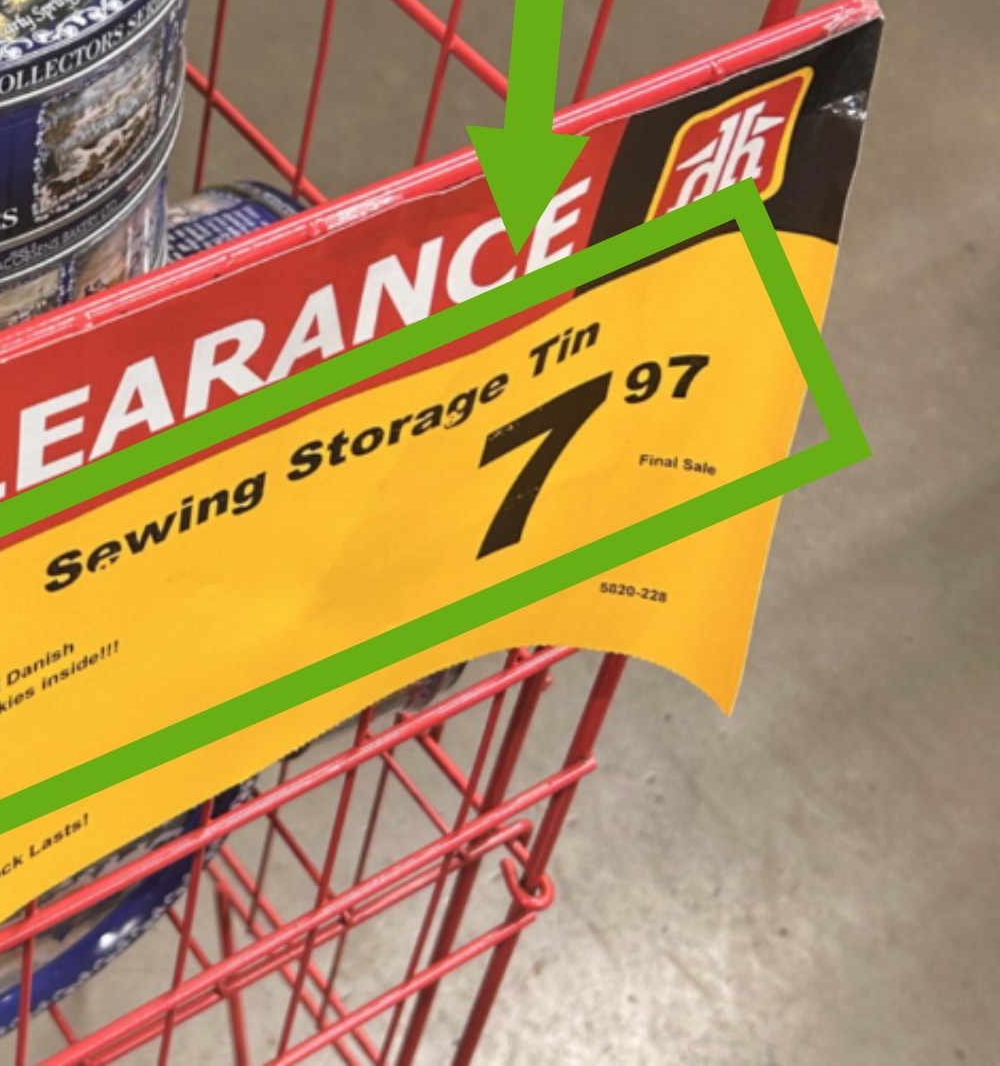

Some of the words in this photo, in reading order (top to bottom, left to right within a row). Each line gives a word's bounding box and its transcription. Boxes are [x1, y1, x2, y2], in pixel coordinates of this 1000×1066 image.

[43, 471, 267, 593] Sewing
[286, 372, 510, 482] Storage
[528, 321, 601, 378] Tin
[475, 370, 614, 561] 7
[624, 354, 711, 405] 97
[638, 453, 680, 470] Final
[682, 457, 718, 477] Sale
[598, 580, 669, 604] 5820-228
[5, 641, 76, 688] Danish
[40, 638, 121, 692] inside!!!
[28, 812, 90, 860] Lasts!
